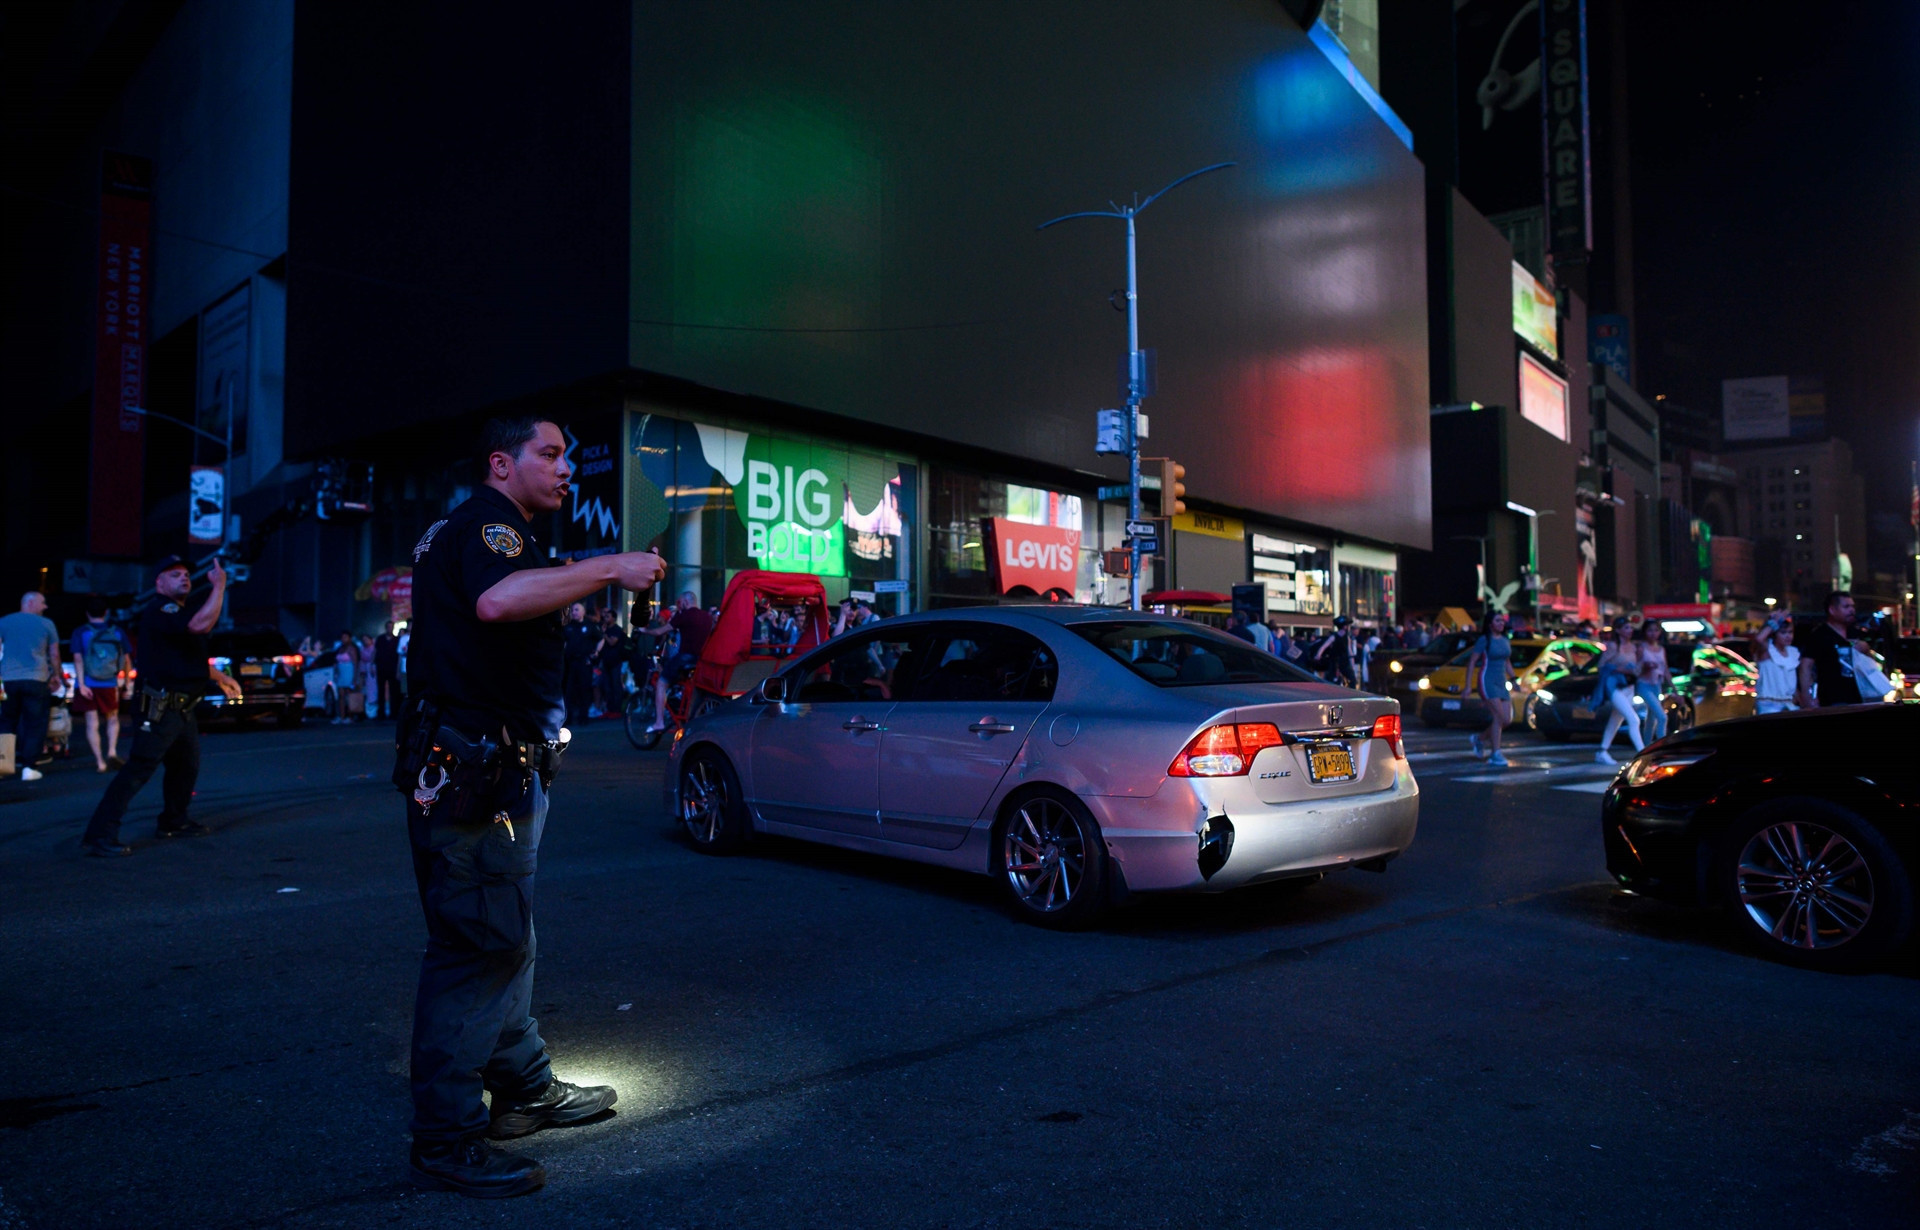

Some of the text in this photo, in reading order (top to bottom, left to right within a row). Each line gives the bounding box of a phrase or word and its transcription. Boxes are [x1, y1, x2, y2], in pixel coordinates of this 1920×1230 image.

[1550, 28, 1579, 207] SQUARE
[105, 242, 121, 336] NEW YORK
[126, 246, 142, 340] MARRIOTT
[747, 459, 831, 527] BIG
[1194, 512, 1225, 532] INVICTA
[747, 521, 831, 562] BOLD
